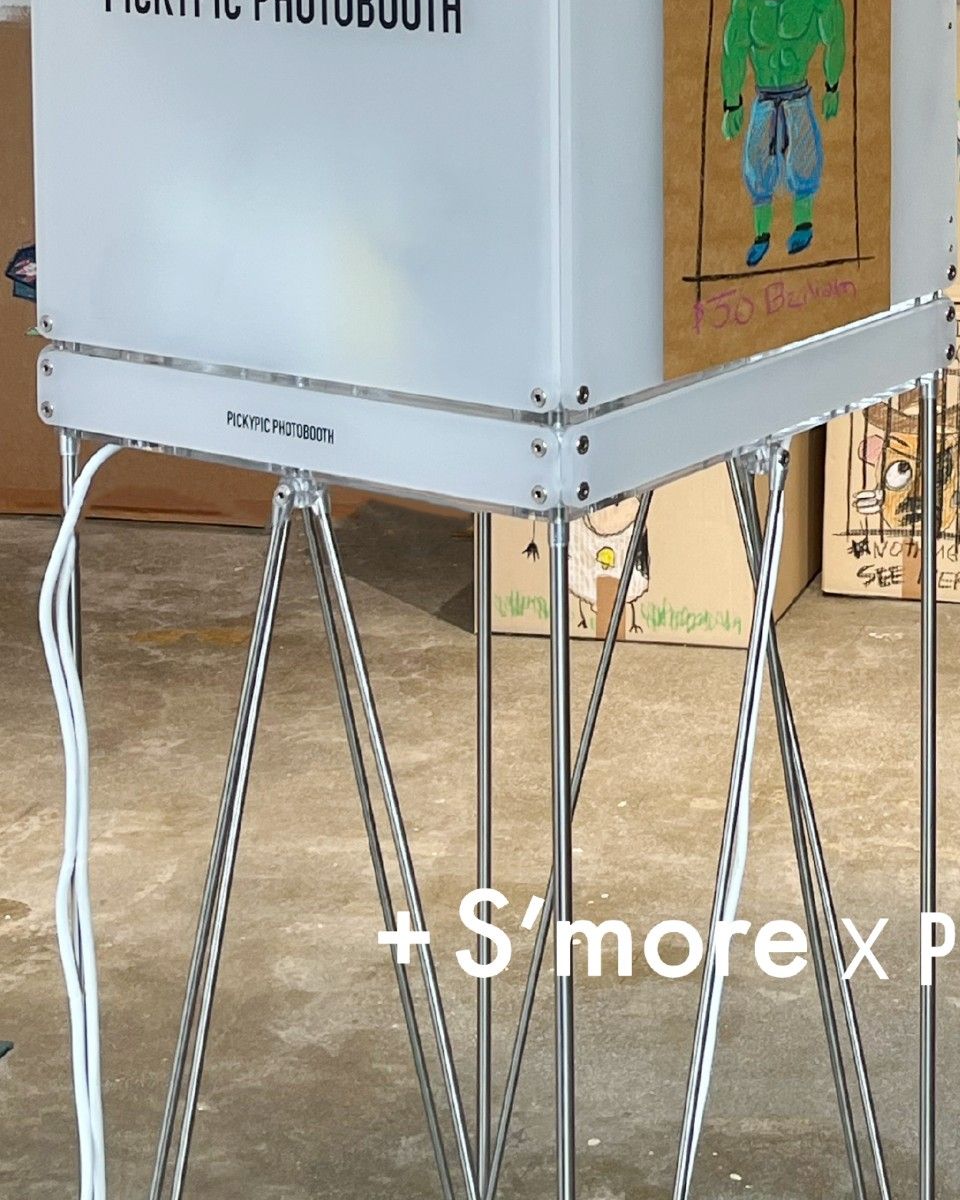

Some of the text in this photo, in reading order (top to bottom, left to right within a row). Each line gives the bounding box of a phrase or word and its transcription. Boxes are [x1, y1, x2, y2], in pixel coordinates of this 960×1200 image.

[227, 410, 335, 445] PICKYPIC PHOTOBOOTH
[856, 564, 904, 588] SEE
